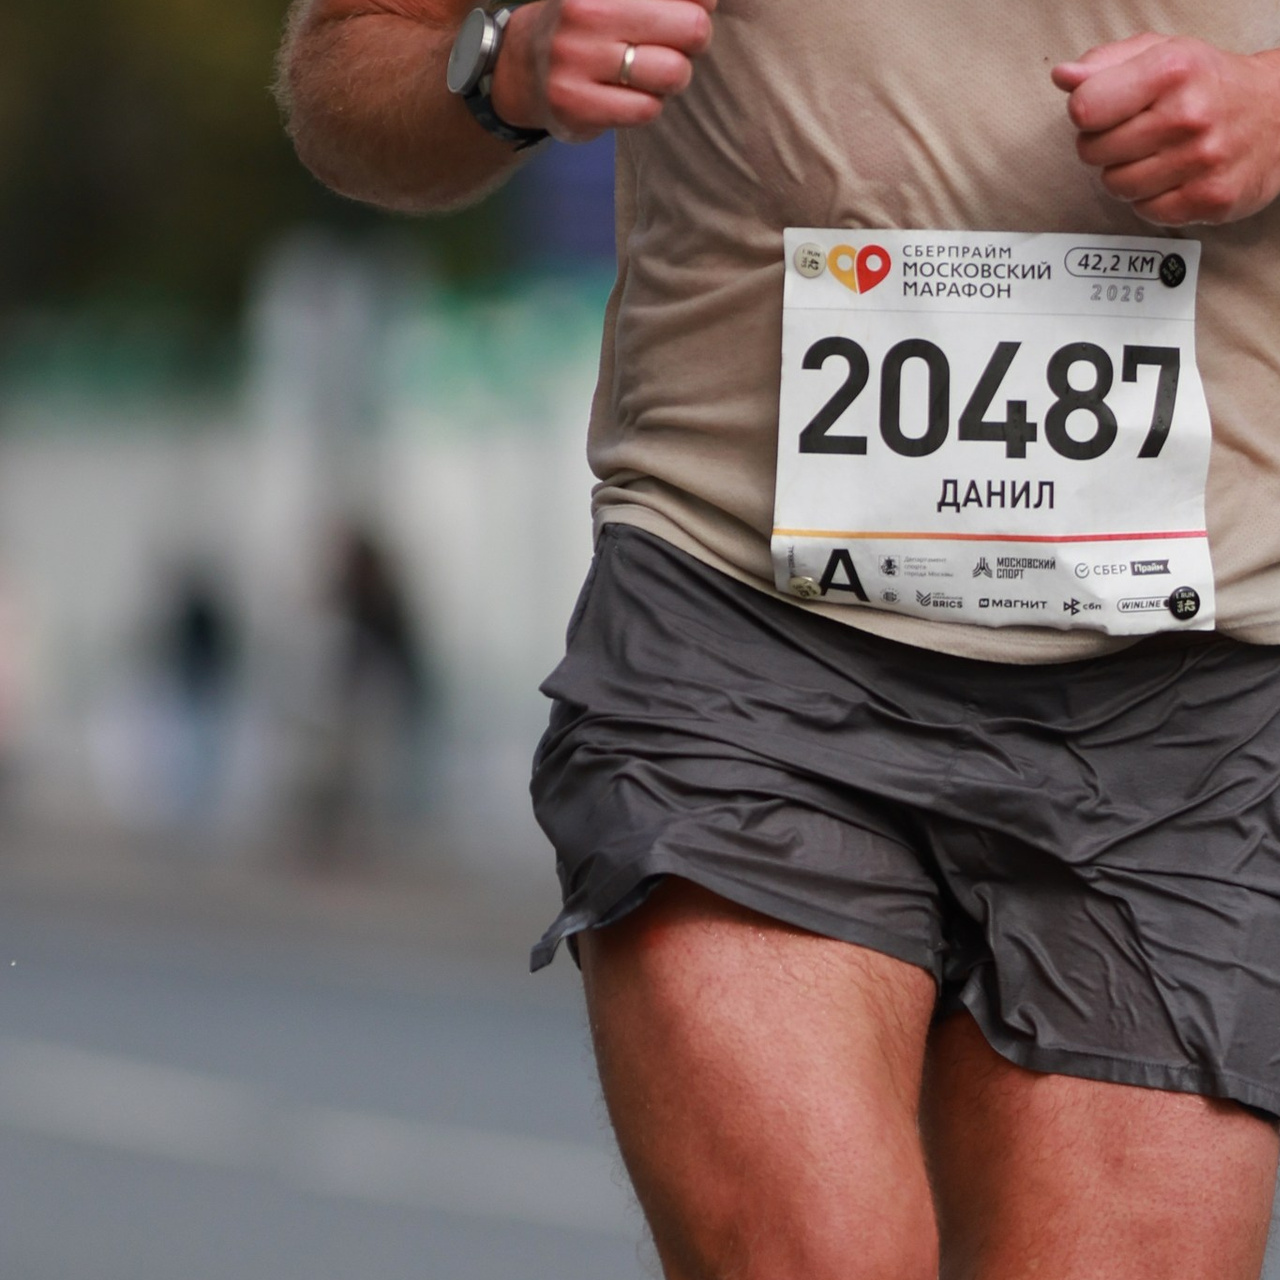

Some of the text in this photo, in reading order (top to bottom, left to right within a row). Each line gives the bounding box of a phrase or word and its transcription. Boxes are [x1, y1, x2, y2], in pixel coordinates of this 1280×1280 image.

[902, 244, 1012, 259] СБЕРПРАЙМ
[902, 261, 1052, 280] МОСКОВСКИЙ
[1077, 254, 1155, 273] 42,2 КМ
[902, 282, 1012, 299] МАРАФОН
[798, 335, 1181, 461] 20487
[936, 478, 1055, 513] ДАНИЛ
[996, 557, 1056, 570] МОСКОВСКИЙ
[1093, 563, 1165, 576] СБЕР Прайм
[996, 568, 1025, 579] СПОРТ
[932, 599, 964, 609] BRICS
[1083, 603, 1102, 611] сбп
[1121, 600, 1161, 610] WINLINE
